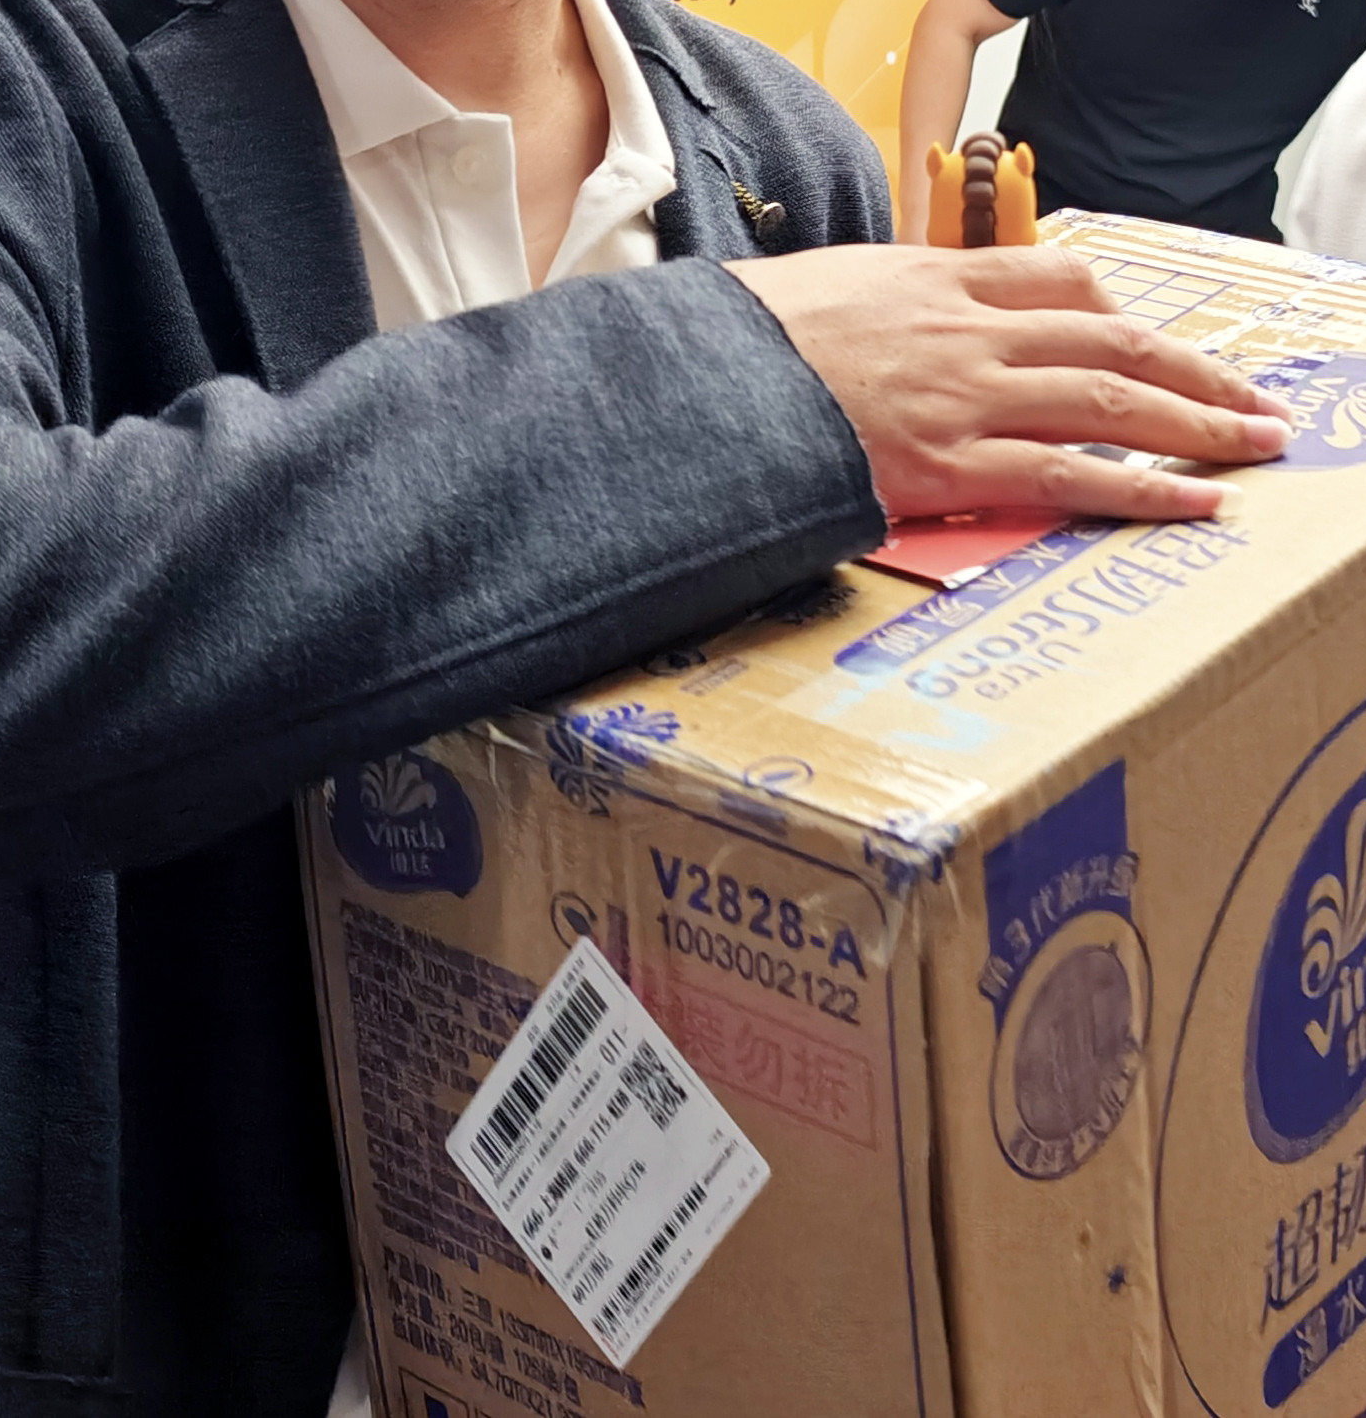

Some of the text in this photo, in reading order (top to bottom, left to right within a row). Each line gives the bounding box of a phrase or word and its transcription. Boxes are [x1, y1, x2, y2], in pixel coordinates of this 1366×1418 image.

[974, 640, 1079, 700] Ultra
[649, 845, 868, 981] V2828-A
[655, 905, 863, 1027] 1003002122
